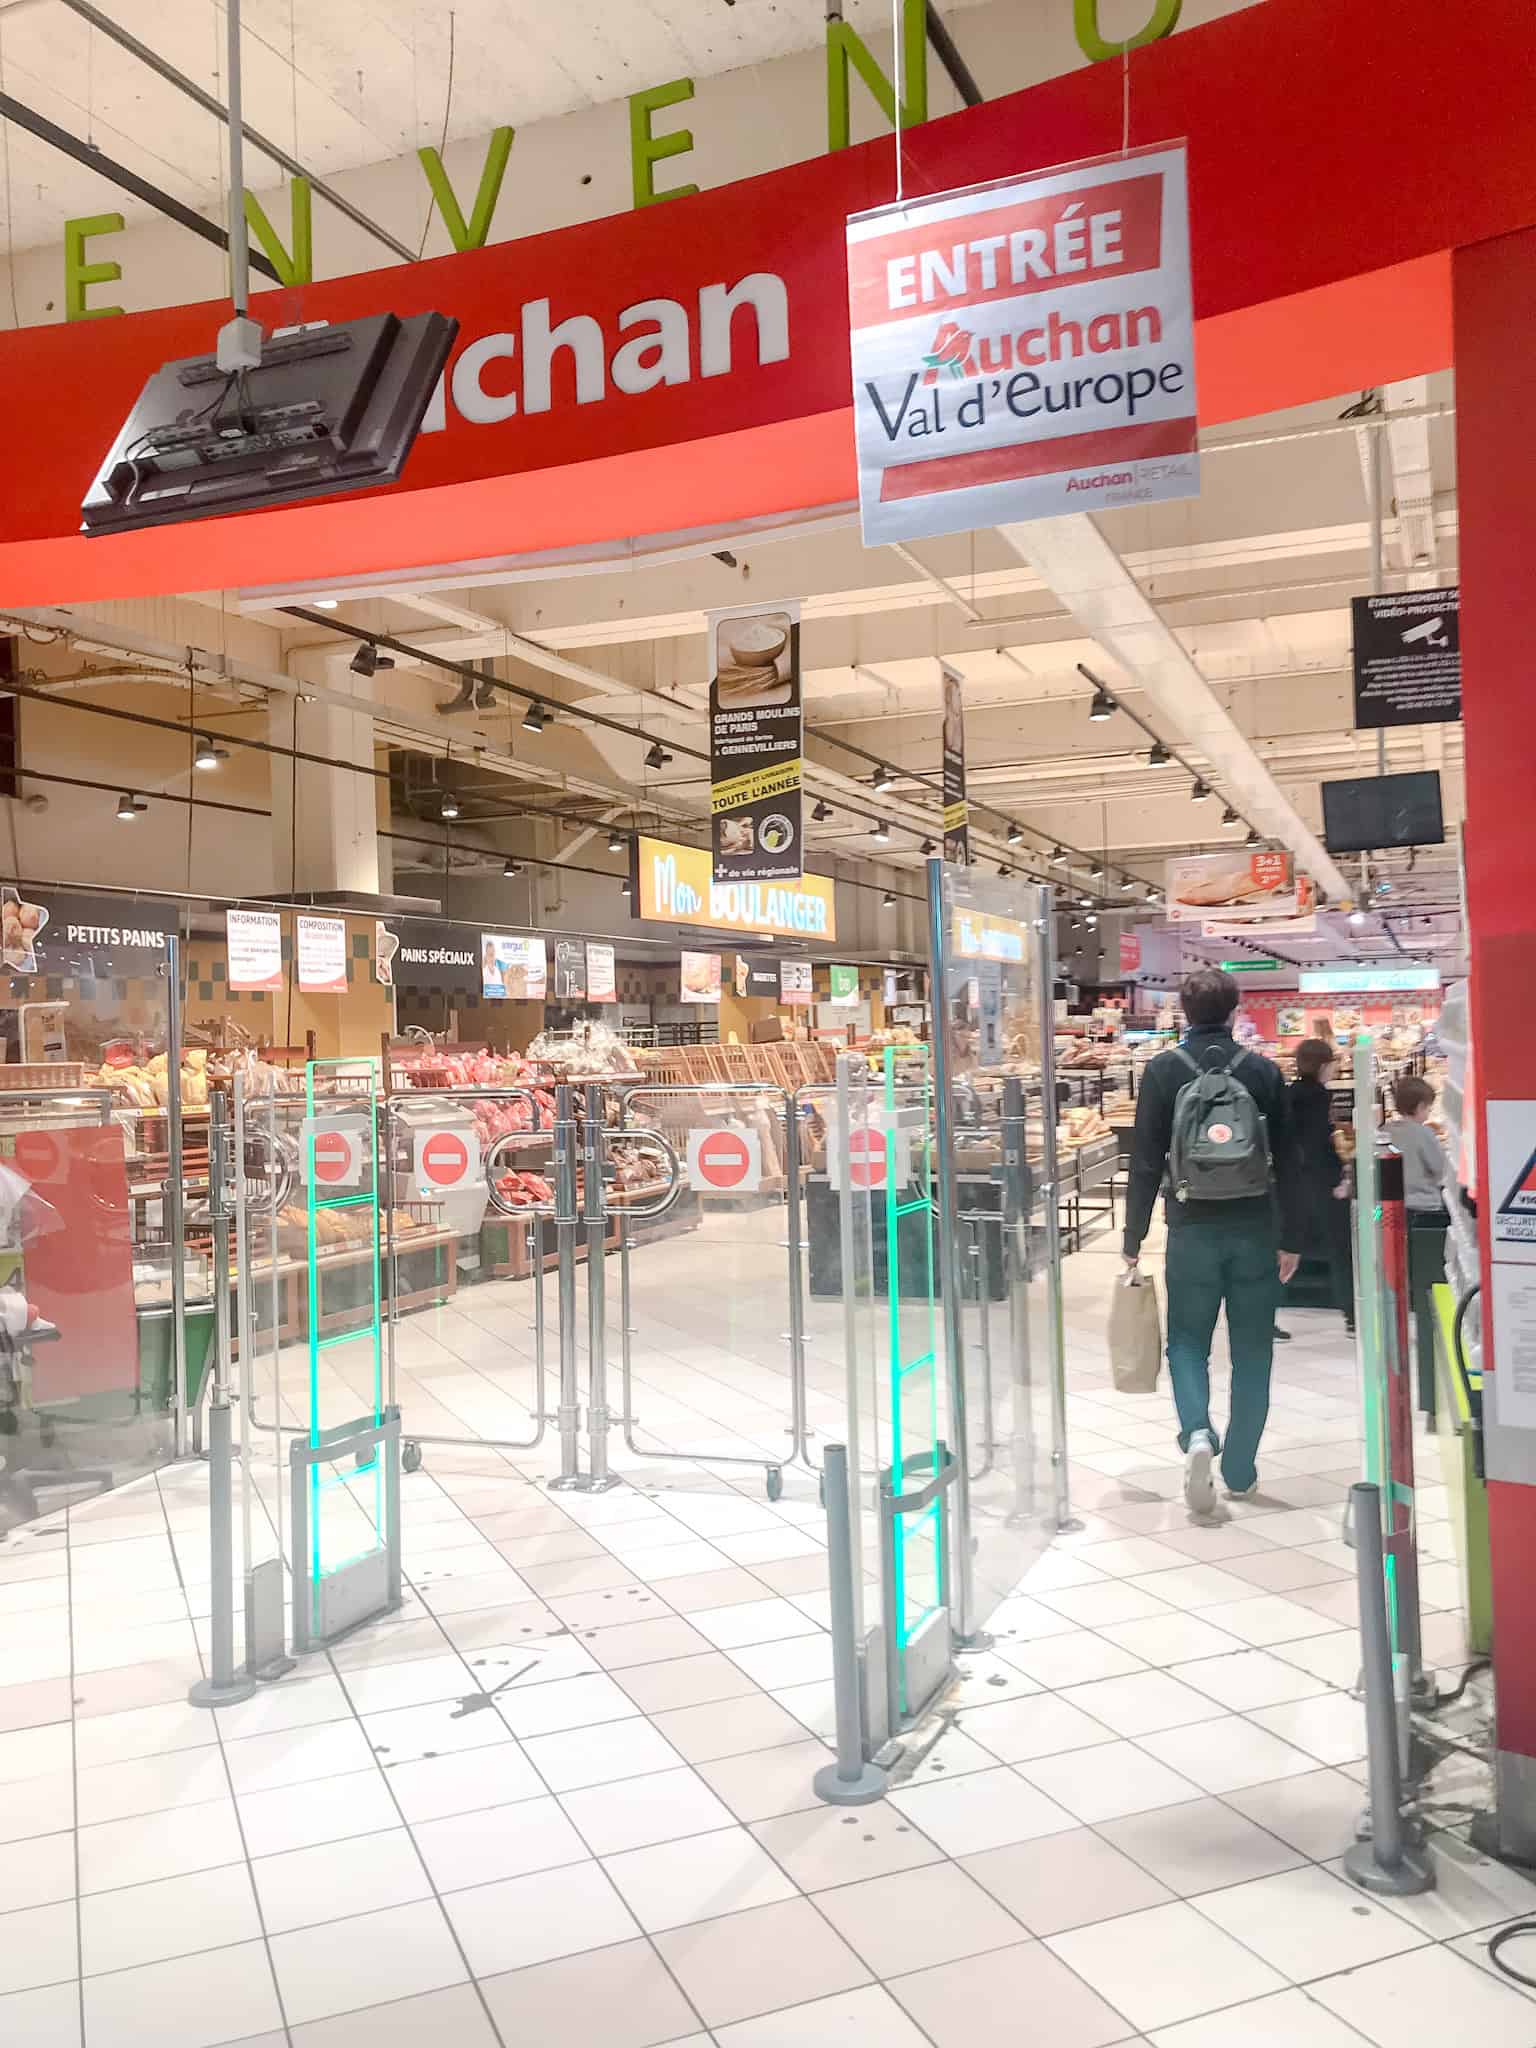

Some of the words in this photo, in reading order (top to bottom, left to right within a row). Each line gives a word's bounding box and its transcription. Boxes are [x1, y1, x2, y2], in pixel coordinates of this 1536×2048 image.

[887, 201, 1123, 310] ENTRÉE
[420, 272, 790, 433] chan
[922, 304, 1162, 386] Auchan
[865, 372, 946, 441] Val
[1066, 471, 1133, 493] Auchan
[714, 711, 754, 724] GRANDS
[756, 707, 800, 720] MOULINS
[714, 725, 728, 735] DE
[729, 721, 758, 733] PARIS
[721, 740, 797, 755] GENNEVILLIERS
[712, 791, 750, 810] TOUTE
[752, 775, 800, 798] L'ANNÉE
[653, 854, 702, 916] Mon
[709, 880, 827, 933] BOULANGER
[229, 913, 279, 926] INFORMATION
[299, 919, 343, 932] COMPOSITION
[67, 925, 120, 945] PETITS
[122, 929, 165, 948] PAINS
[401, 948, 427, 963] PAINS
[428, 948, 474, 966] SPÉCIAUX
